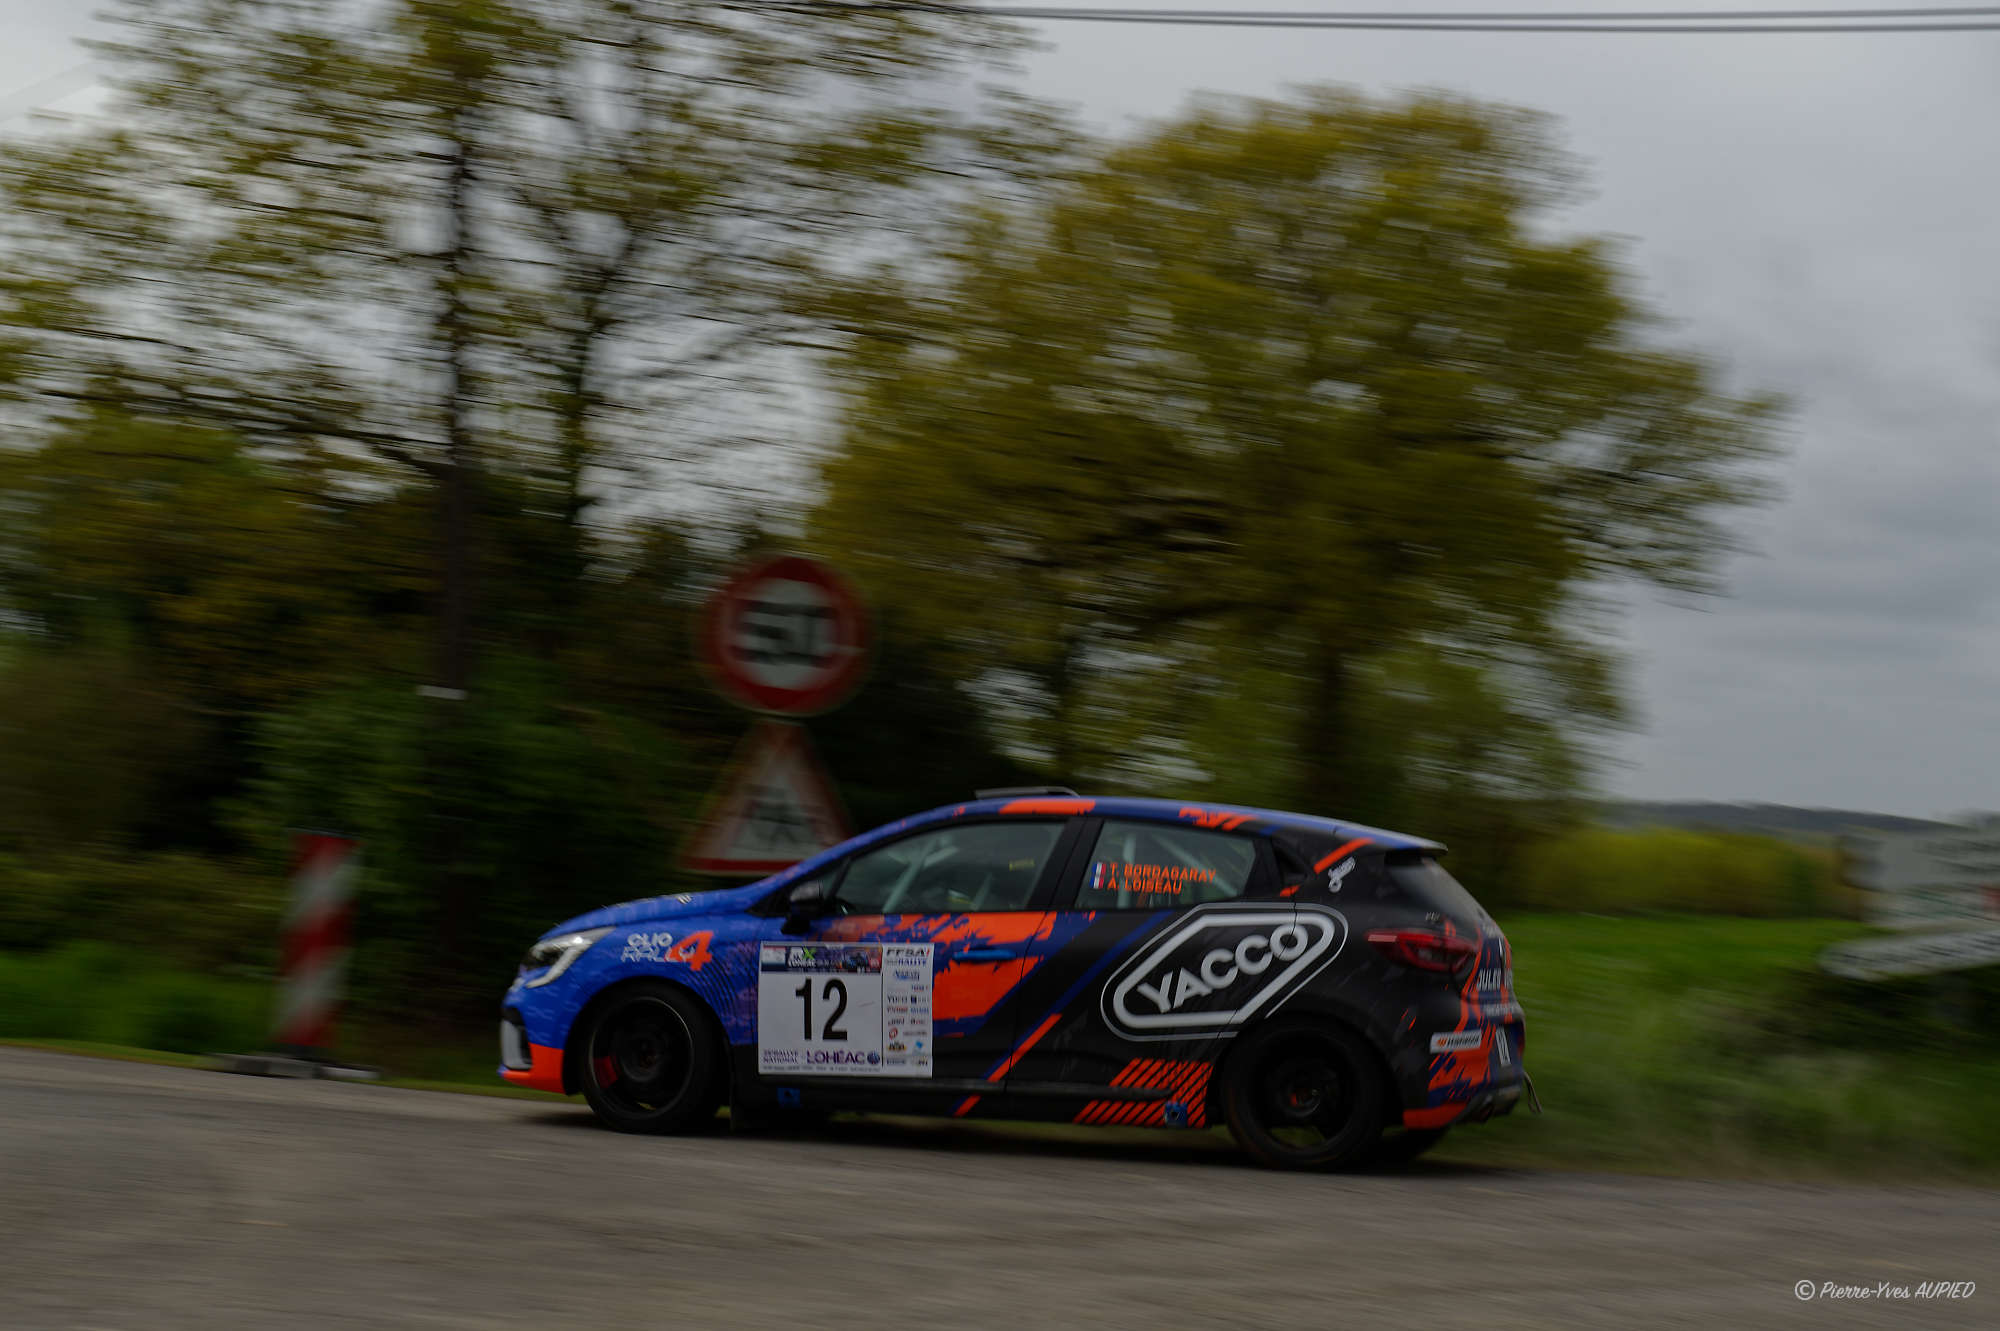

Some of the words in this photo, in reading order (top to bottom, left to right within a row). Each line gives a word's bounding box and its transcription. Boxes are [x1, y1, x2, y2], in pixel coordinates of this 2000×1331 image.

[1106, 876, 1119, 890] A.
[1109, 862, 1119, 876] T.
[1123, 863, 1217, 884] BORDAGARAY
[665, 930, 715, 972] 4
[1136, 922, 1310, 1015] YACCO
[795, 977, 848, 1041] 12
